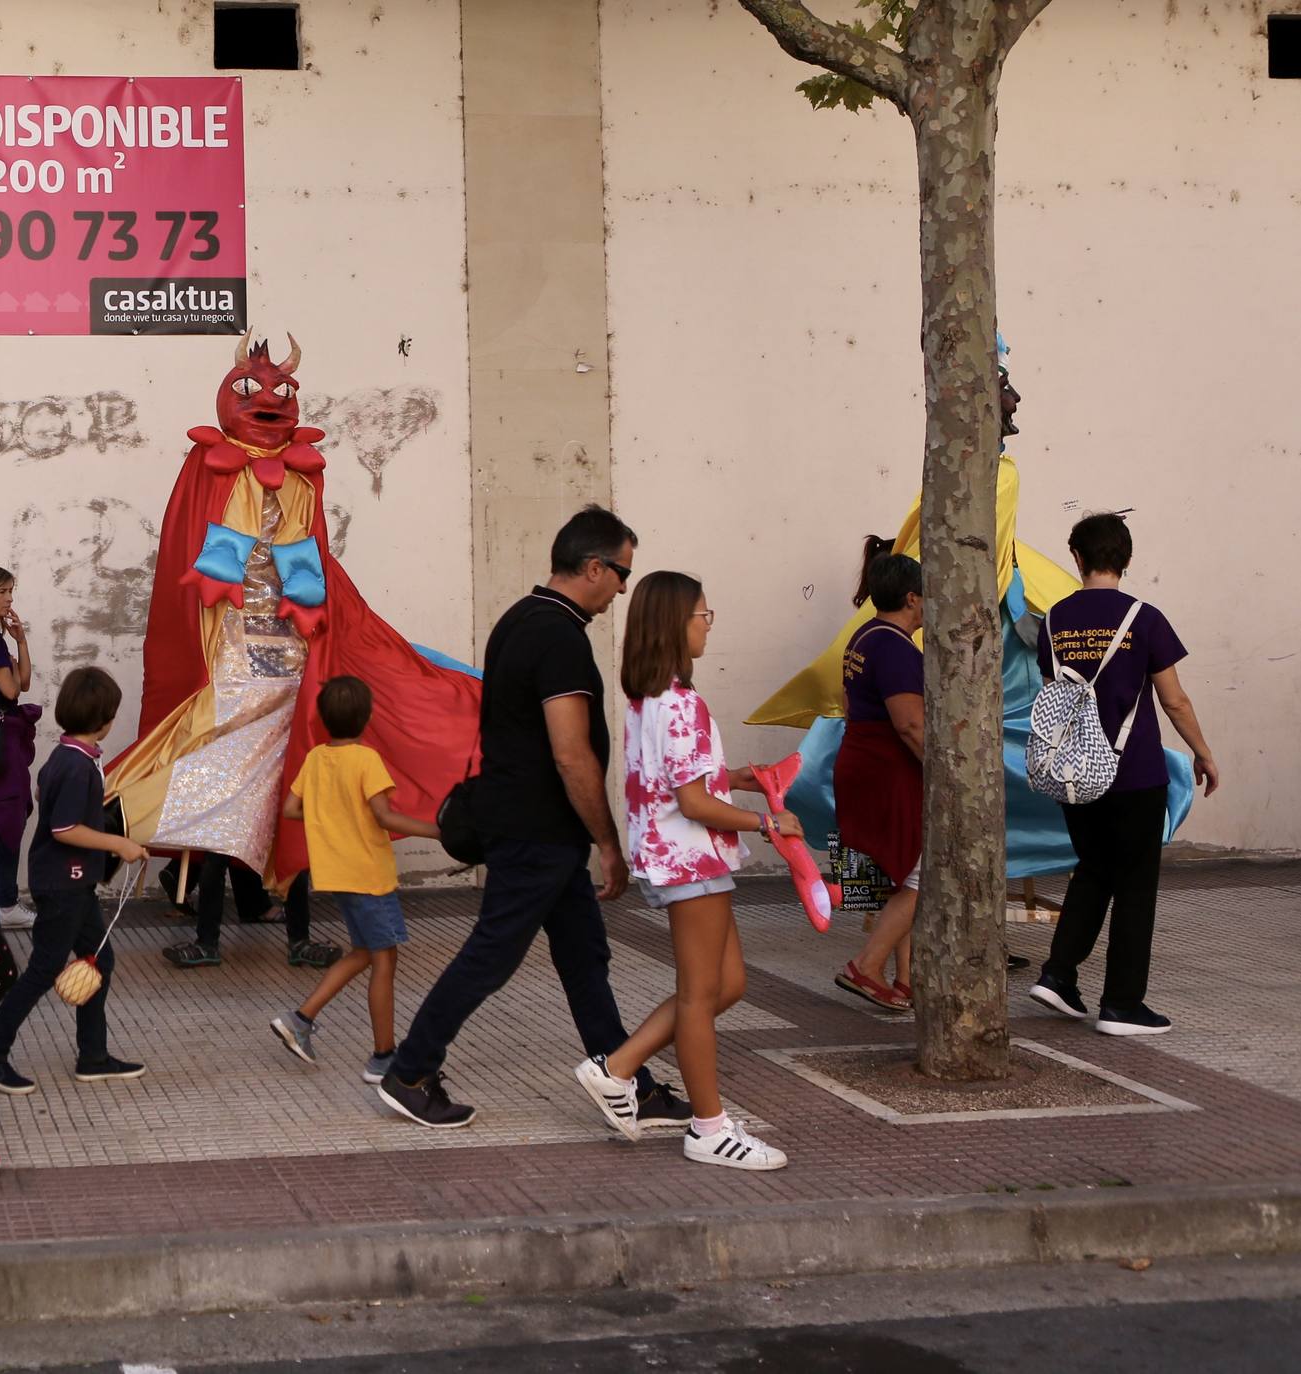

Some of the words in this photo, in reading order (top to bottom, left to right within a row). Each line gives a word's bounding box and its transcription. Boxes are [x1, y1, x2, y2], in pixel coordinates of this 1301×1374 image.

[72, 210, 139, 262] 73
[155, 210, 221, 262] 73
[103, 282, 234, 311] casaktua
[103, 312, 133, 322] donde
[133, 312, 150, 322] vive
[151, 313, 161, 322] tu
[162, 314, 181, 322] casa
[183, 314, 190, 324] y
[190, 313, 200, 322] tu
[201, 312, 235, 324] negocio
[70, 866, 83, 879] 5
[843, 886, 870, 895] BAG
[843, 902, 879, 910] SHOPPING
